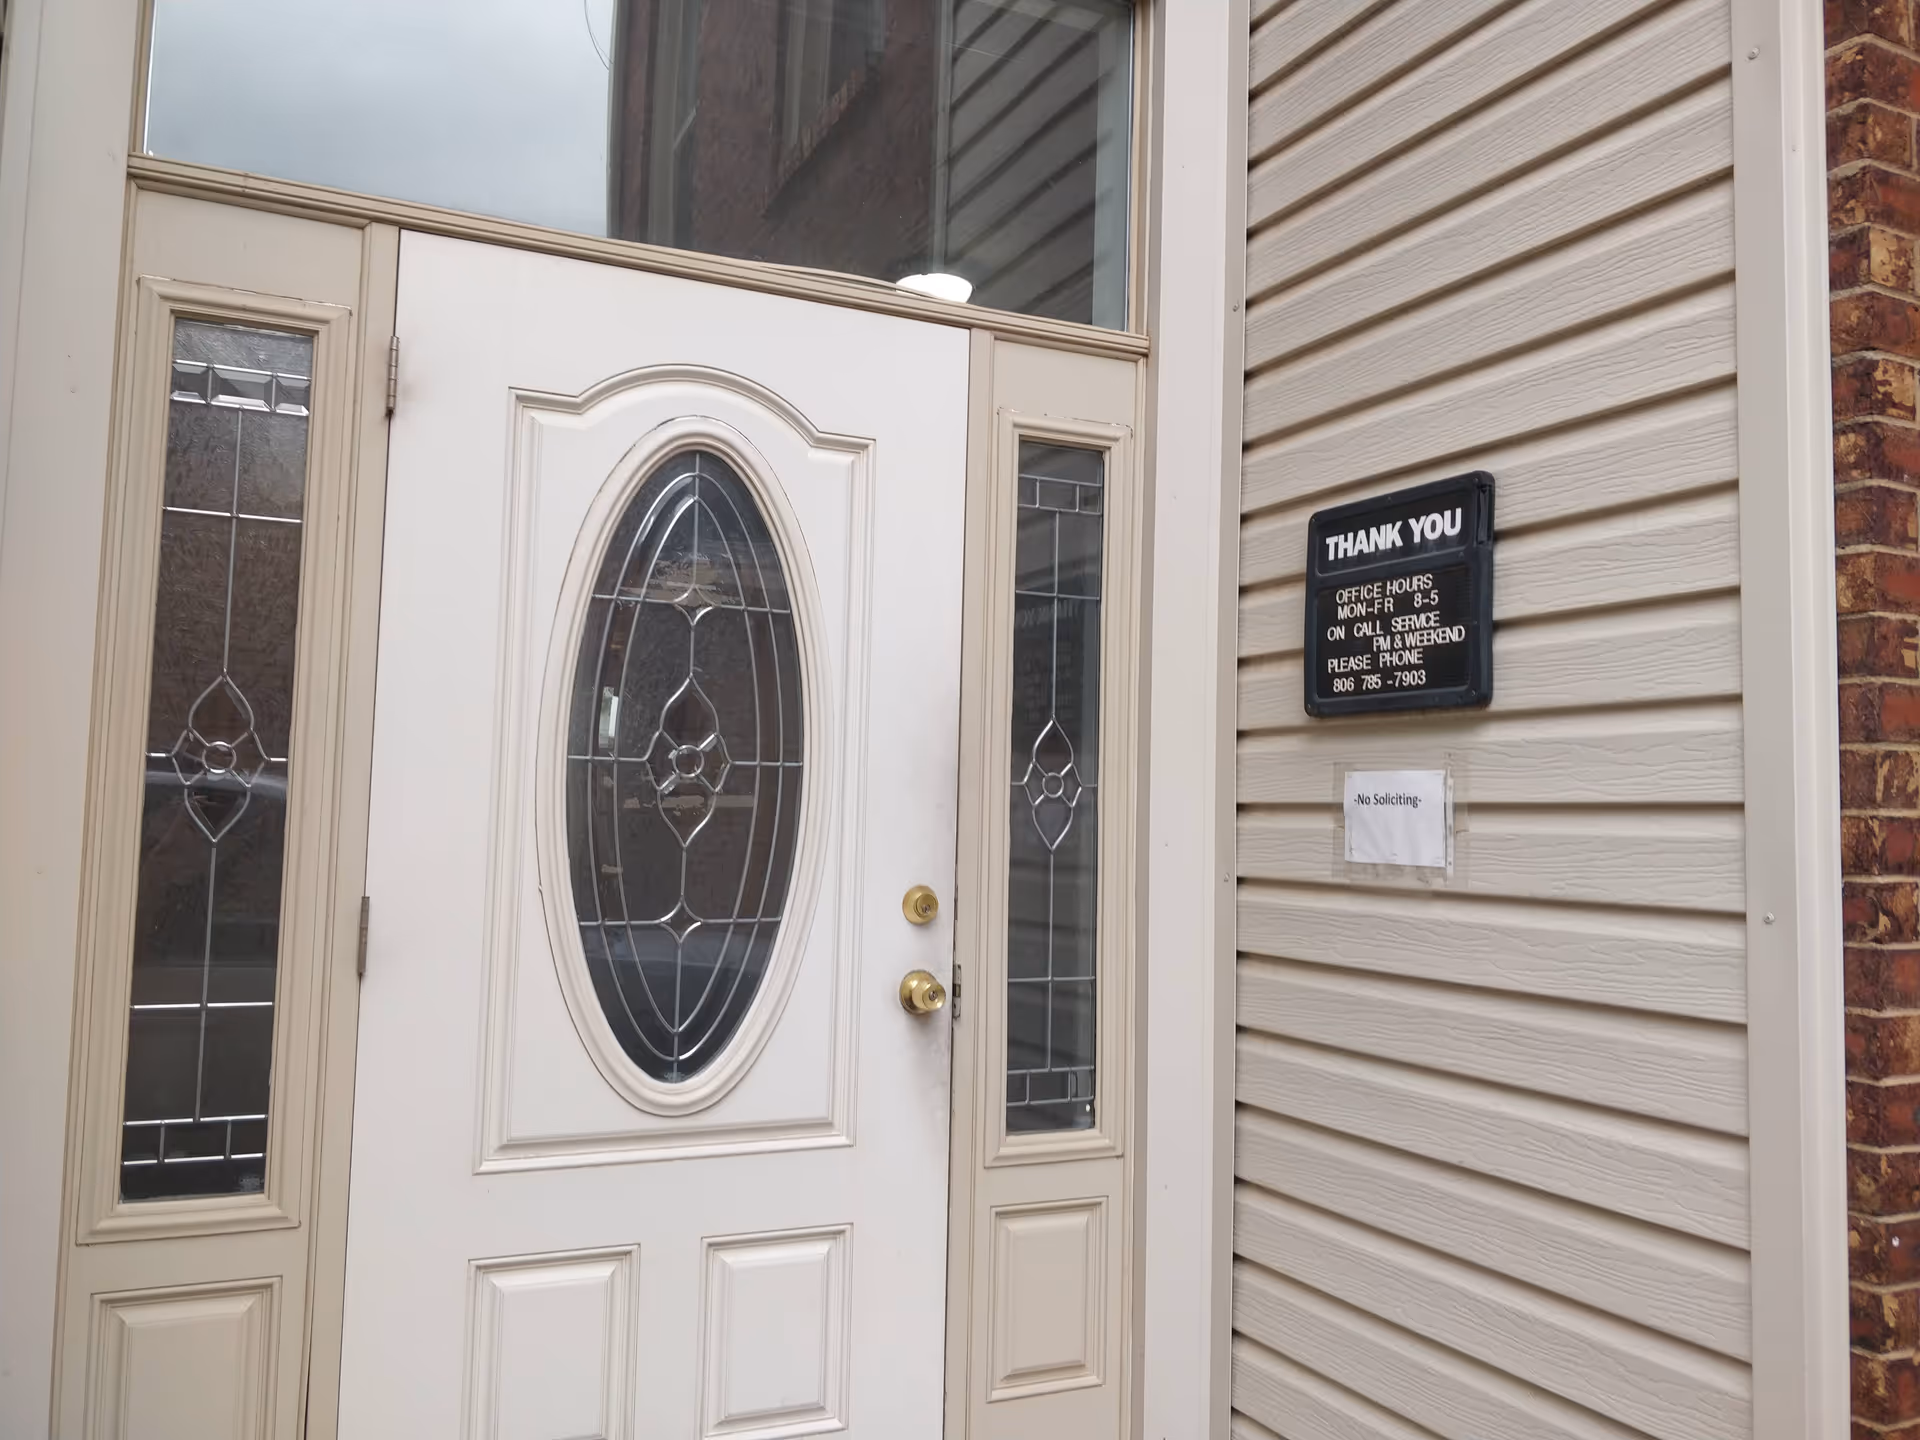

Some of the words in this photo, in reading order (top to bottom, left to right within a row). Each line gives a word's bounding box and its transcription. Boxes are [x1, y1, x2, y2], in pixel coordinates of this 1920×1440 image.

[1326, 521, 1403, 561] THANK
[1408, 508, 1462, 543] YOU
[1336, 582, 1382, 604] OFFICE
[1387, 573, 1433, 596] HOURS
[1413, 590, 1439, 608] 8-5
[1327, 625, 1345, 641] ON
[1354, 620, 1383, 637] CALL
[1391, 611, 1440, 632] SERVICE
[1373, 635, 1391, 652] PM
[1393, 634, 1402, 649] &
[1404, 625, 1466, 647] WEEKEND
[1328, 655, 1371, 673] PLEASE
[1379, 648, 1423, 668] PHONE
[1333, 677, 1354, 693] 806
[1361, 674, 1381, 691] 785
